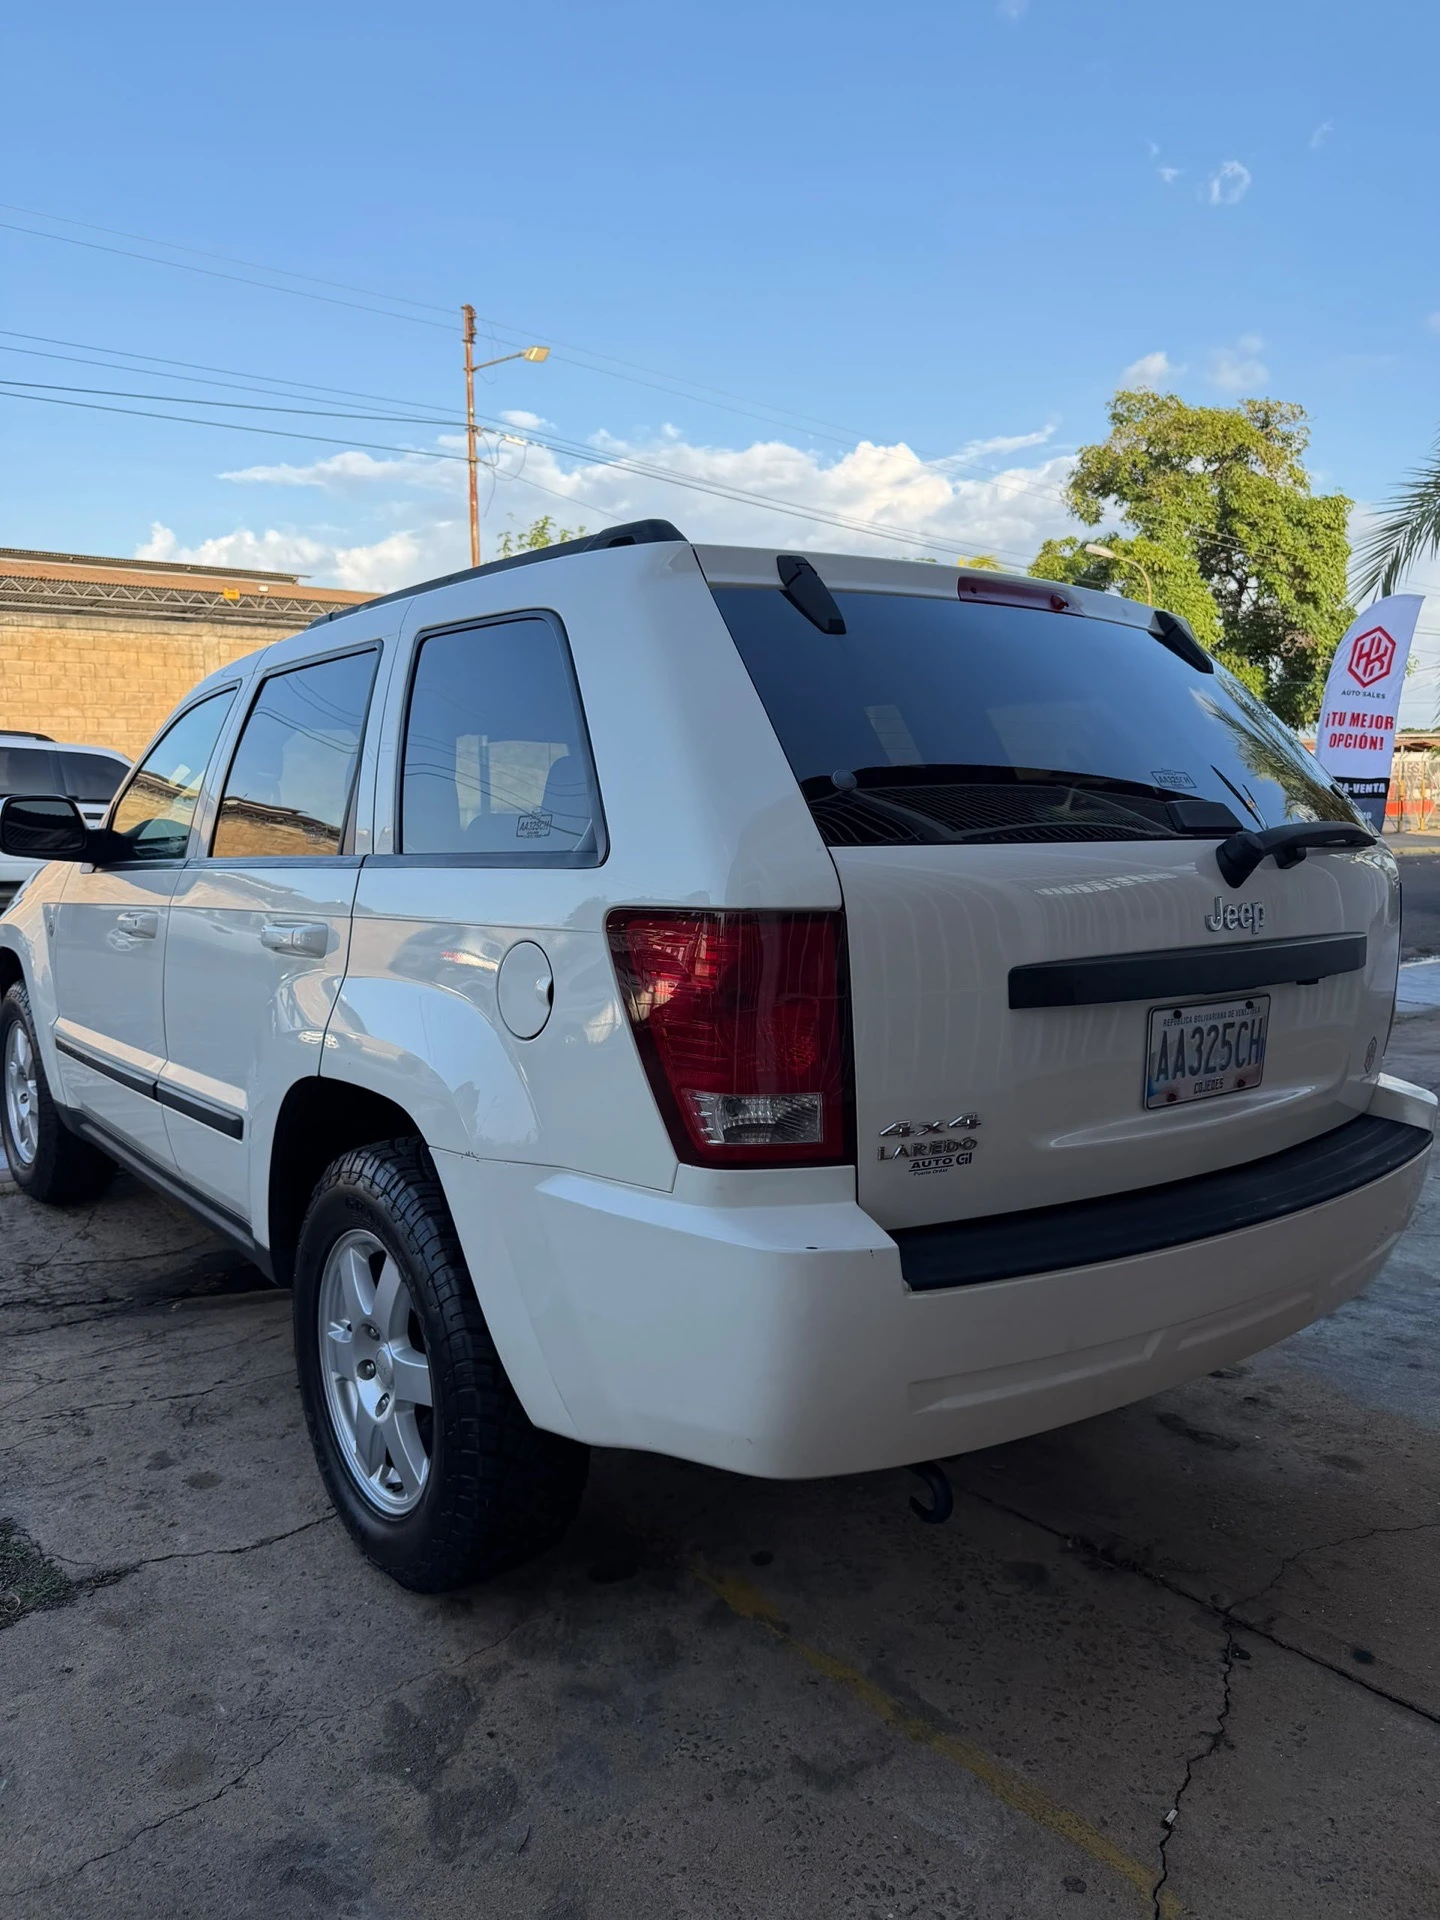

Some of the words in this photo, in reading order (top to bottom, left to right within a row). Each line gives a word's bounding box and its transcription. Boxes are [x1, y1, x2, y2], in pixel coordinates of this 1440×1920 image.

[1341, 689, 1361, 697] AUTO
[1362, 691, 1386, 700] SALES
[1325, 711, 1347, 728] ¡TU
[1349, 712, 1394, 730] MEJOR
[1329, 733, 1384, 750] OPCIÓN!
[1205, 896, 1265, 935] Jeep
[1228, 1009, 1235, 1018] DE
[1156, 1018, 1263, 1083] AA325CH
[1194, 1076, 1224, 1094] COJEDES
[877, 1137, 978, 1161] LAREDO
[911, 1157, 954, 1170] AUTO
